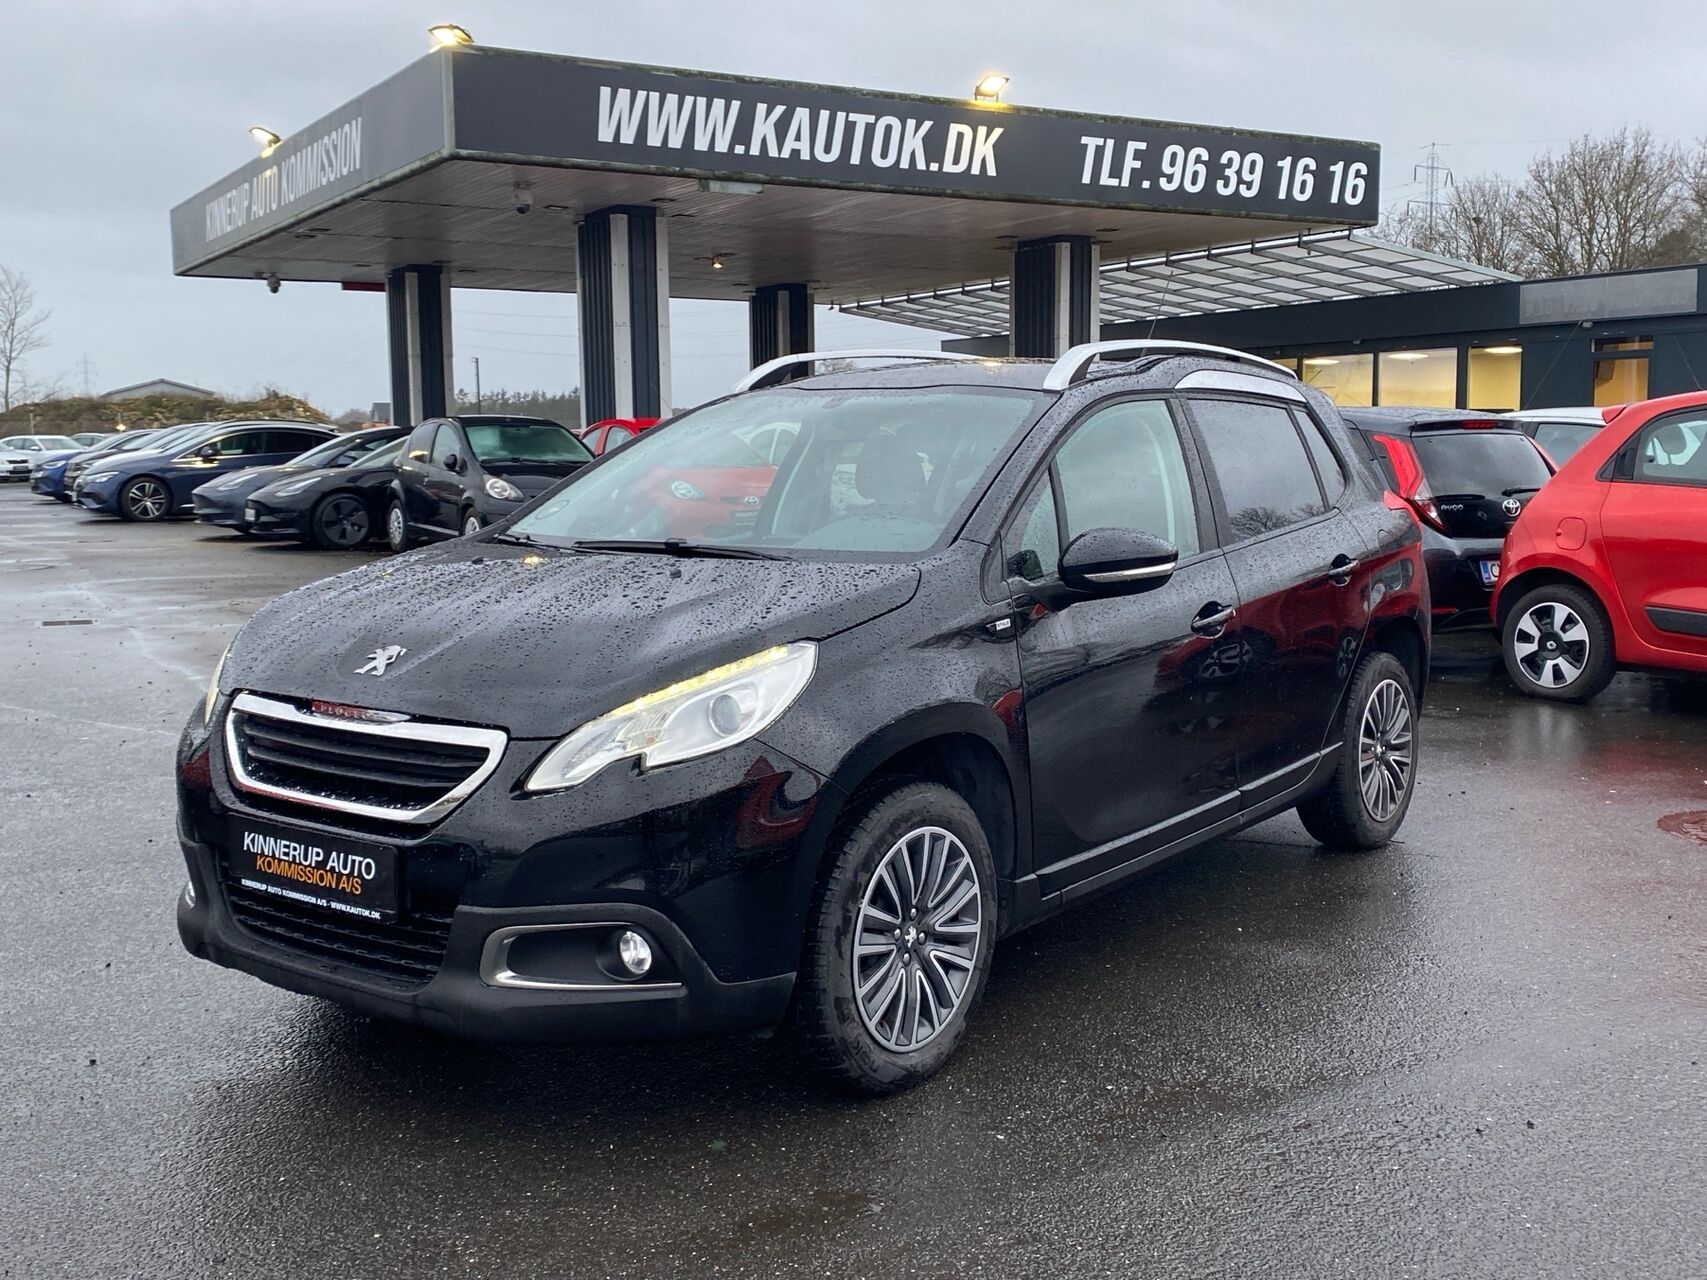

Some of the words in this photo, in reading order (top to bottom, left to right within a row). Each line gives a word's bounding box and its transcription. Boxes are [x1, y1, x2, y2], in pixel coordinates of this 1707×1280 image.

[598, 86, 1004, 177] WWW.KAUTOK.DK
[206, 182, 249, 242] KINNERUP
[251, 165, 279, 220] AUTO
[281, 117, 362, 206] KOMMISSION
[1080, 136, 1150, 189] TLF.
[1159, 144, 1209, 193] 96
[1216, 150, 1264, 198] 39
[1277, 155, 1317, 202] 16
[1329, 161, 1368, 206] 16
[243, 831, 324, 867] KINNERUP
[326, 851, 375, 880] AUTO
[256, 855, 337, 889] KOMMISSION
[339, 876, 362, 895] A/S
[267, 885, 282, 896] AUTO
